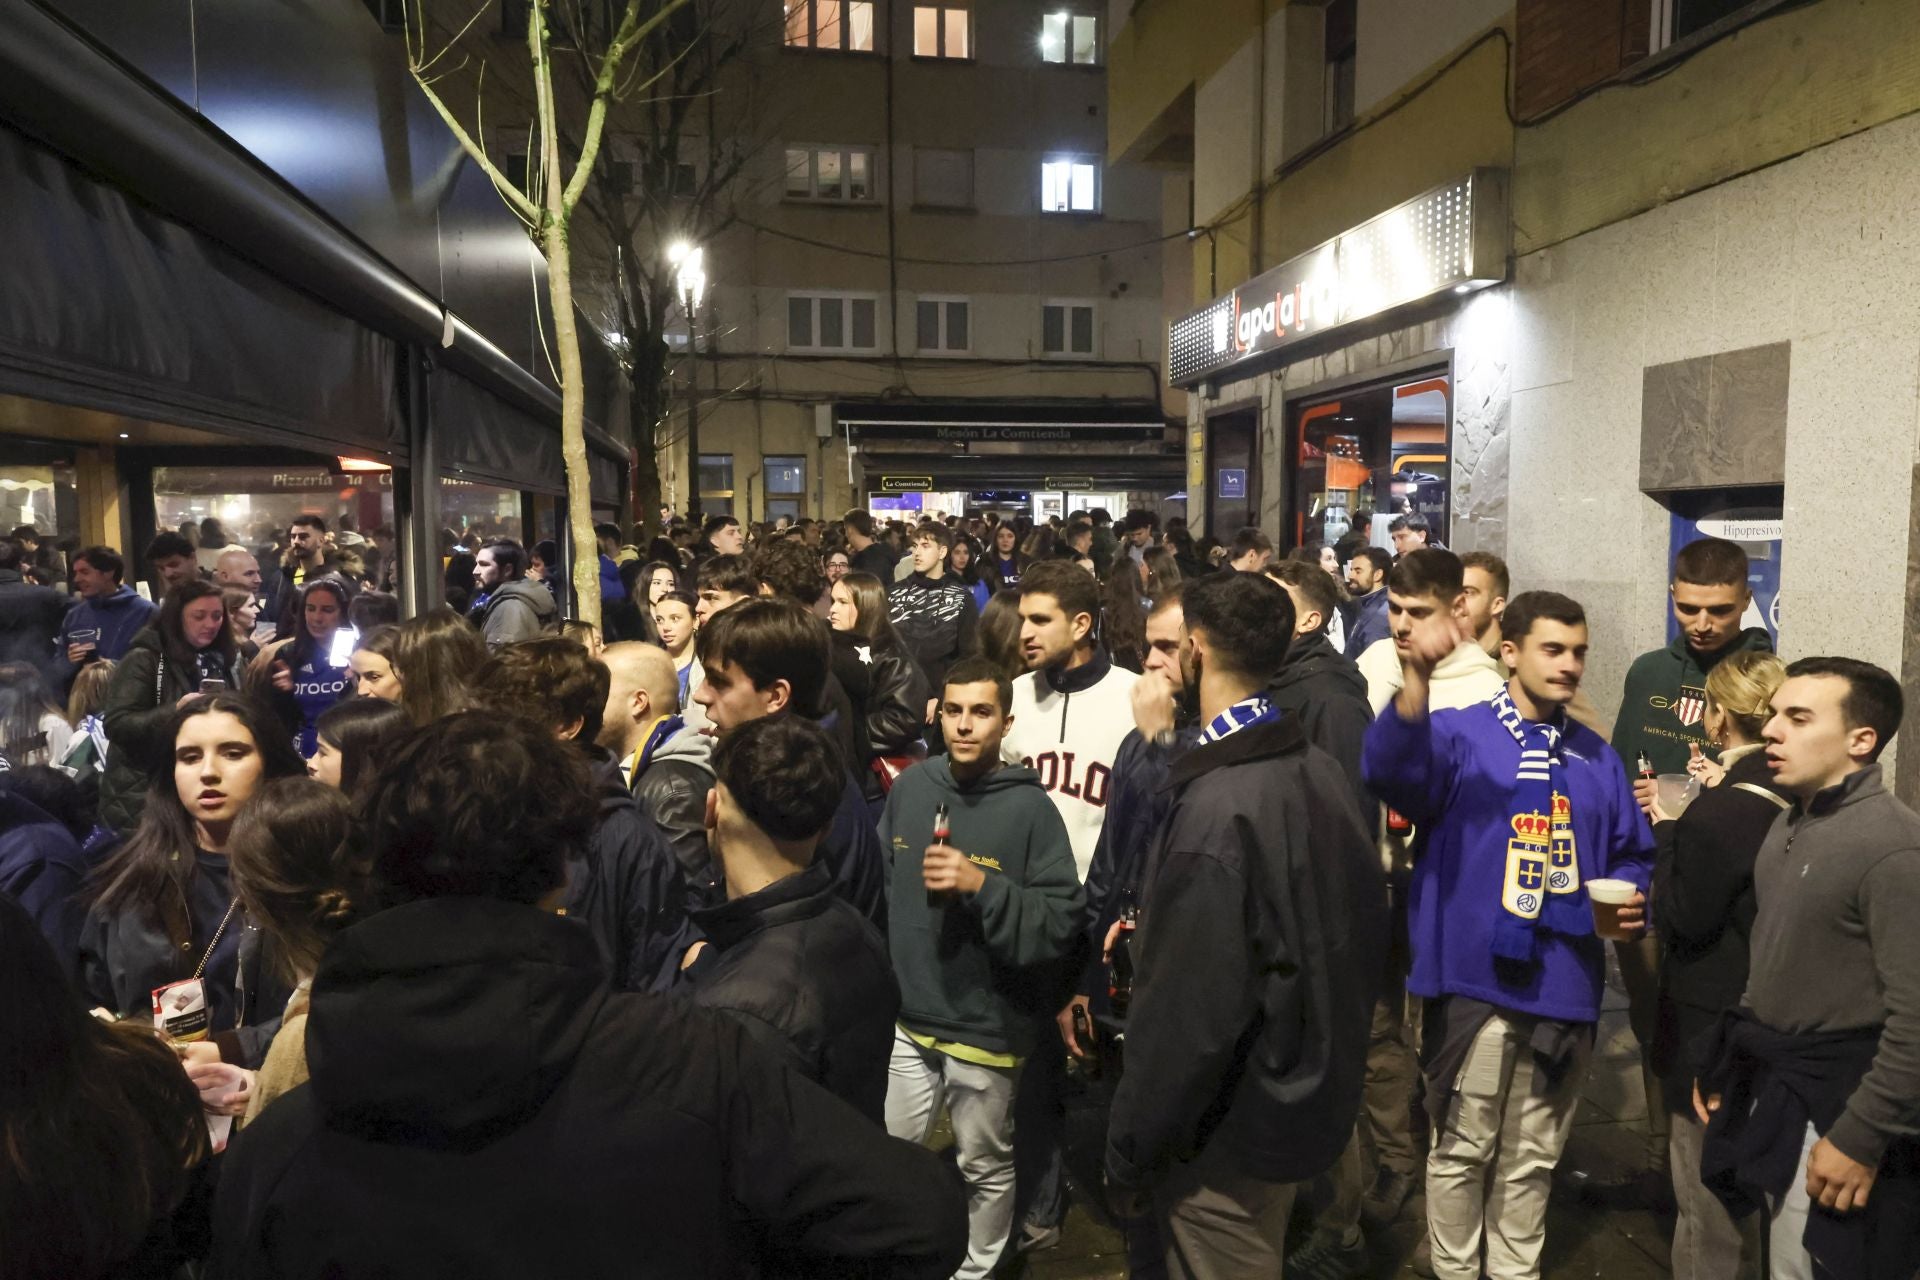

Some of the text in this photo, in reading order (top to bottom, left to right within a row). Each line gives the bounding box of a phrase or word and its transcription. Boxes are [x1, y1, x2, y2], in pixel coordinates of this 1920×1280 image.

[937, 428, 979, 439] Mesón
[984, 429, 998, 439] La
[272, 473, 333, 487] Pizzería
